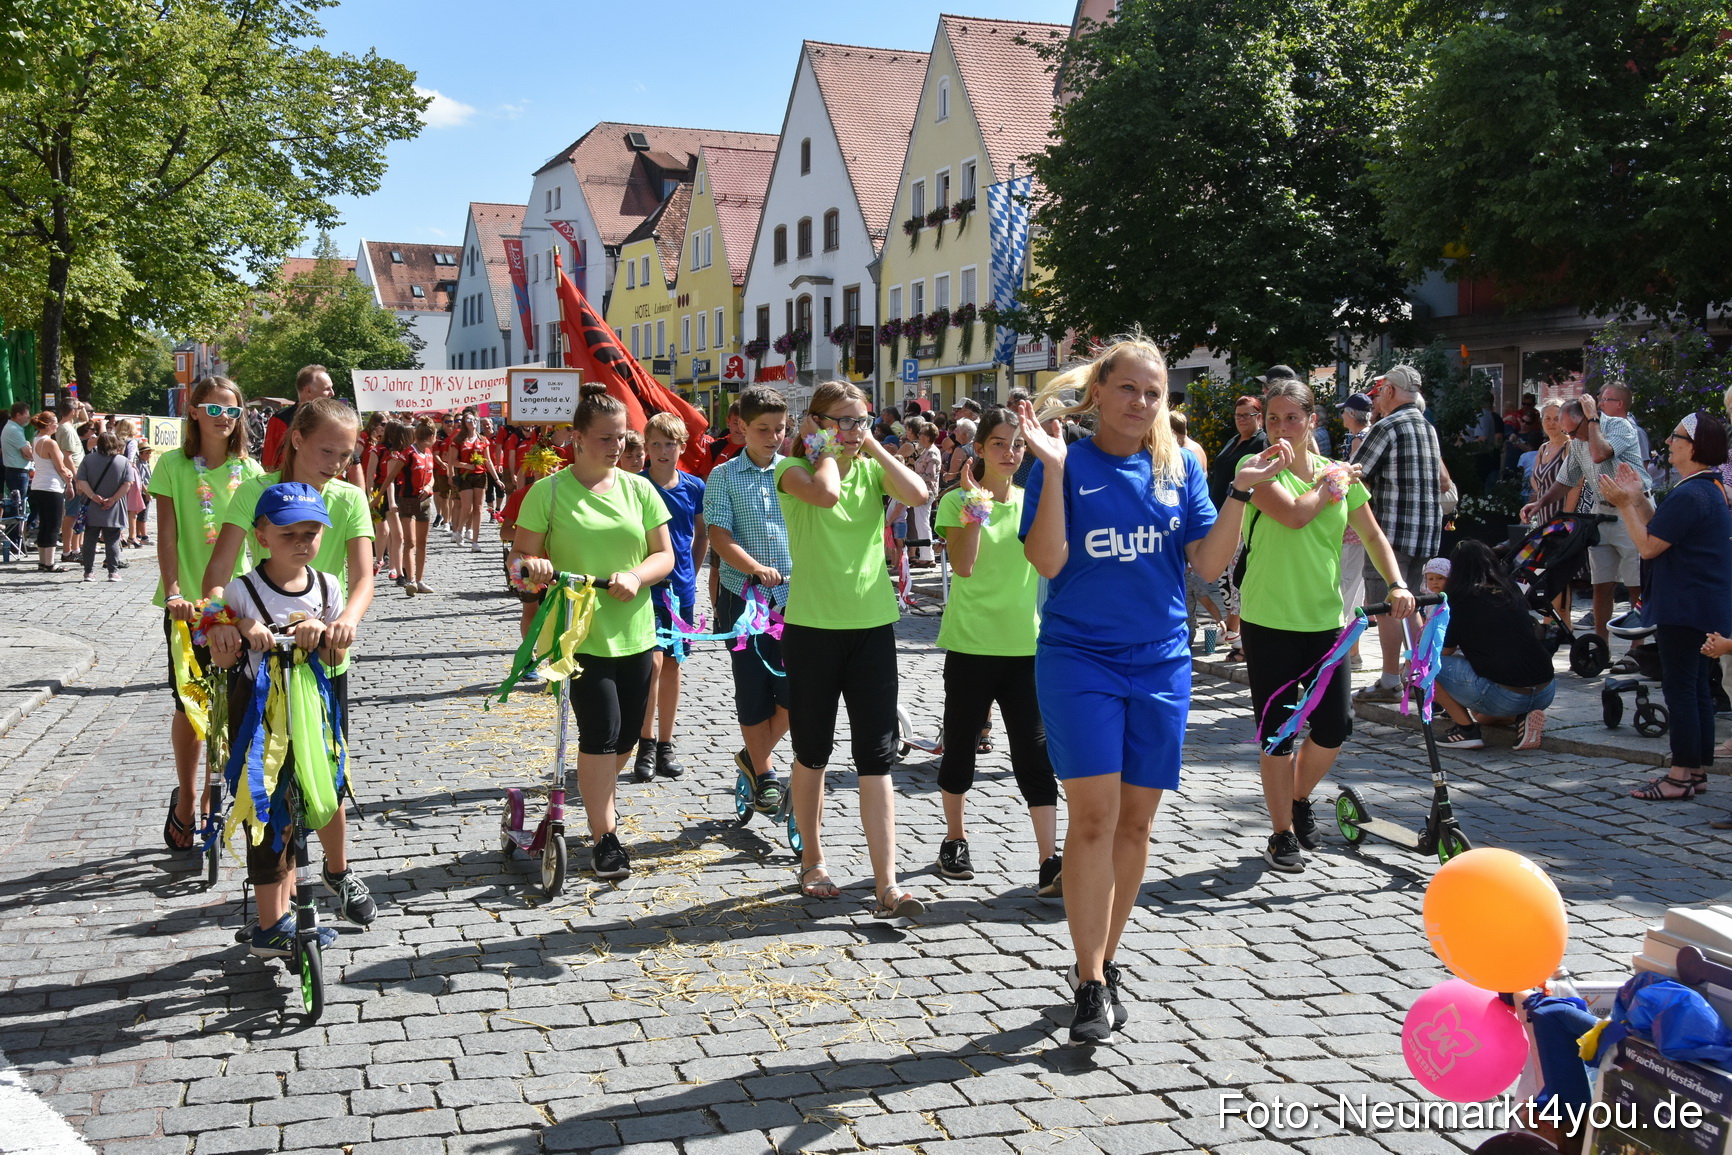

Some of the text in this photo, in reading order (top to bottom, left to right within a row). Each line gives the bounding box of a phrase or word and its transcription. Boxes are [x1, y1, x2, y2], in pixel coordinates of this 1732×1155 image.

[634, 303, 651, 319] HOTEL
[698, 362, 707, 371] FUN
[906, 362, 915, 380] P
[362, 376, 378, 392] 50
[382, 375, 414, 392] Jahre
[419, 375, 464, 395] DJK-SV
[394, 393, 491, 408] 10.06.20 14.06.20
[519, 396, 558, 404] Lengenfeld
[283, 494, 294, 502] SV
[1407, 1037, 1441, 1083] Müller
[1625, 1047, 1637, 1061] Wir
[1635, 1056, 1665, 1075] suchen
[1666, 1067, 1724, 1103] Verstärkung!
